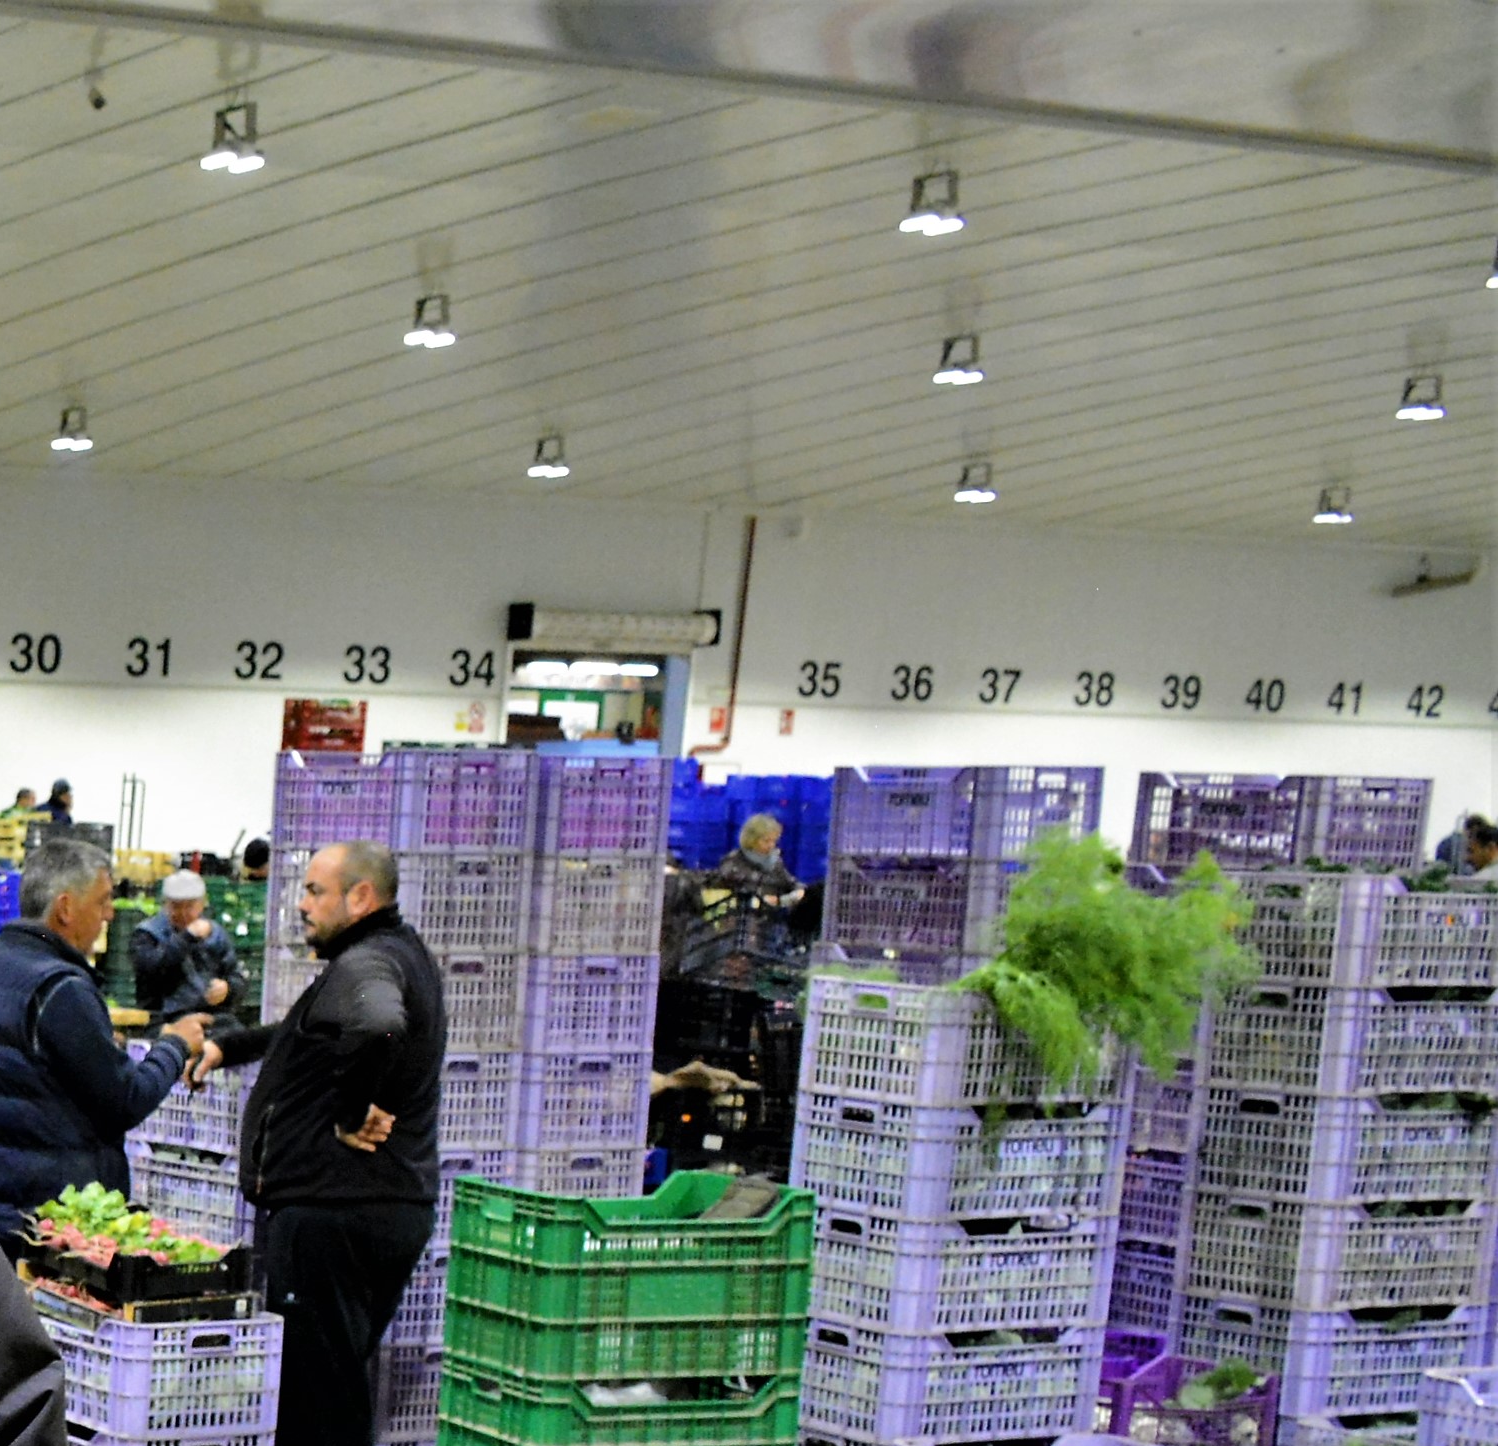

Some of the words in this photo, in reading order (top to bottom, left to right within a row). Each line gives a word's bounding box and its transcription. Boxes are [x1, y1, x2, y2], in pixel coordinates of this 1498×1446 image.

[10, 633, 61, 673] 30
[127, 638, 171, 676] 31
[235, 641, 283, 679] 32
[344, 645, 390, 683] 33
[450, 650, 494, 686] 34
[799, 662, 841, 697] 35
[892, 665, 933, 700] 36
[979, 669, 1021, 703] 37
[1075, 672, 1114, 706] 38
[1162, 675, 1201, 709] 39
[1246, 678, 1284, 711] 40
[1328, 682, 1362, 714] 41
[1407, 684, 1444, 717] 42
[1004, 1138, 1055, 1154] romeu
[989, 1252, 1040, 1267] romeu
[974, 1363, 1025, 1379] romeu
